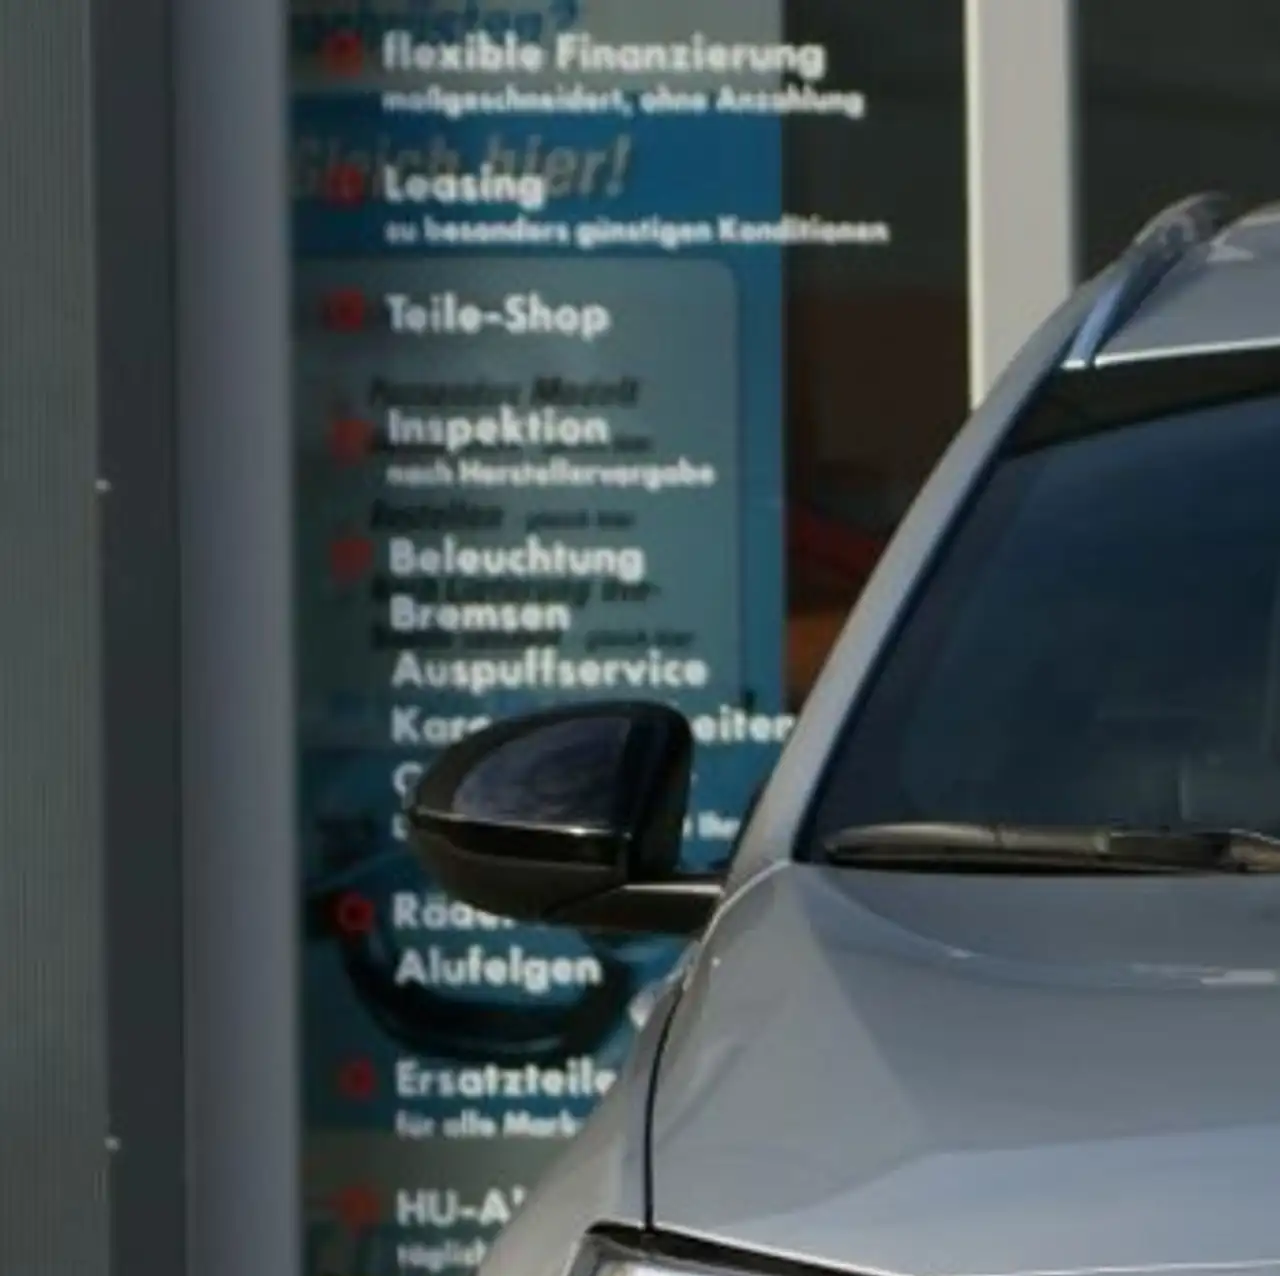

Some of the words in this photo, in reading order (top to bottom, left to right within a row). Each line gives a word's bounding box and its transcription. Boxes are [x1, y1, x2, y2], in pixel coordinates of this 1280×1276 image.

[383, 30, 542, 71] flexible
[556, 30, 828, 78] Finanzierung
[384, 164, 546, 212] Leasing
[385, 294, 611, 340] Teile-Shop
[387, 405, 610, 453] Inspektion
[389, 535, 645, 580] Beleuchtung
[390, 597, 571, 632] Bremsen
[391, 648, 708, 694] Auspuffservice
[395, 944, 603, 993] Alufelgen
[395, 1058, 617, 1098] Ersatzteile
[443, 1108, 496, 1138] alle
[503, 1109, 583, 1138] Mark
[397, 1186, 527, 1226] HU-A
